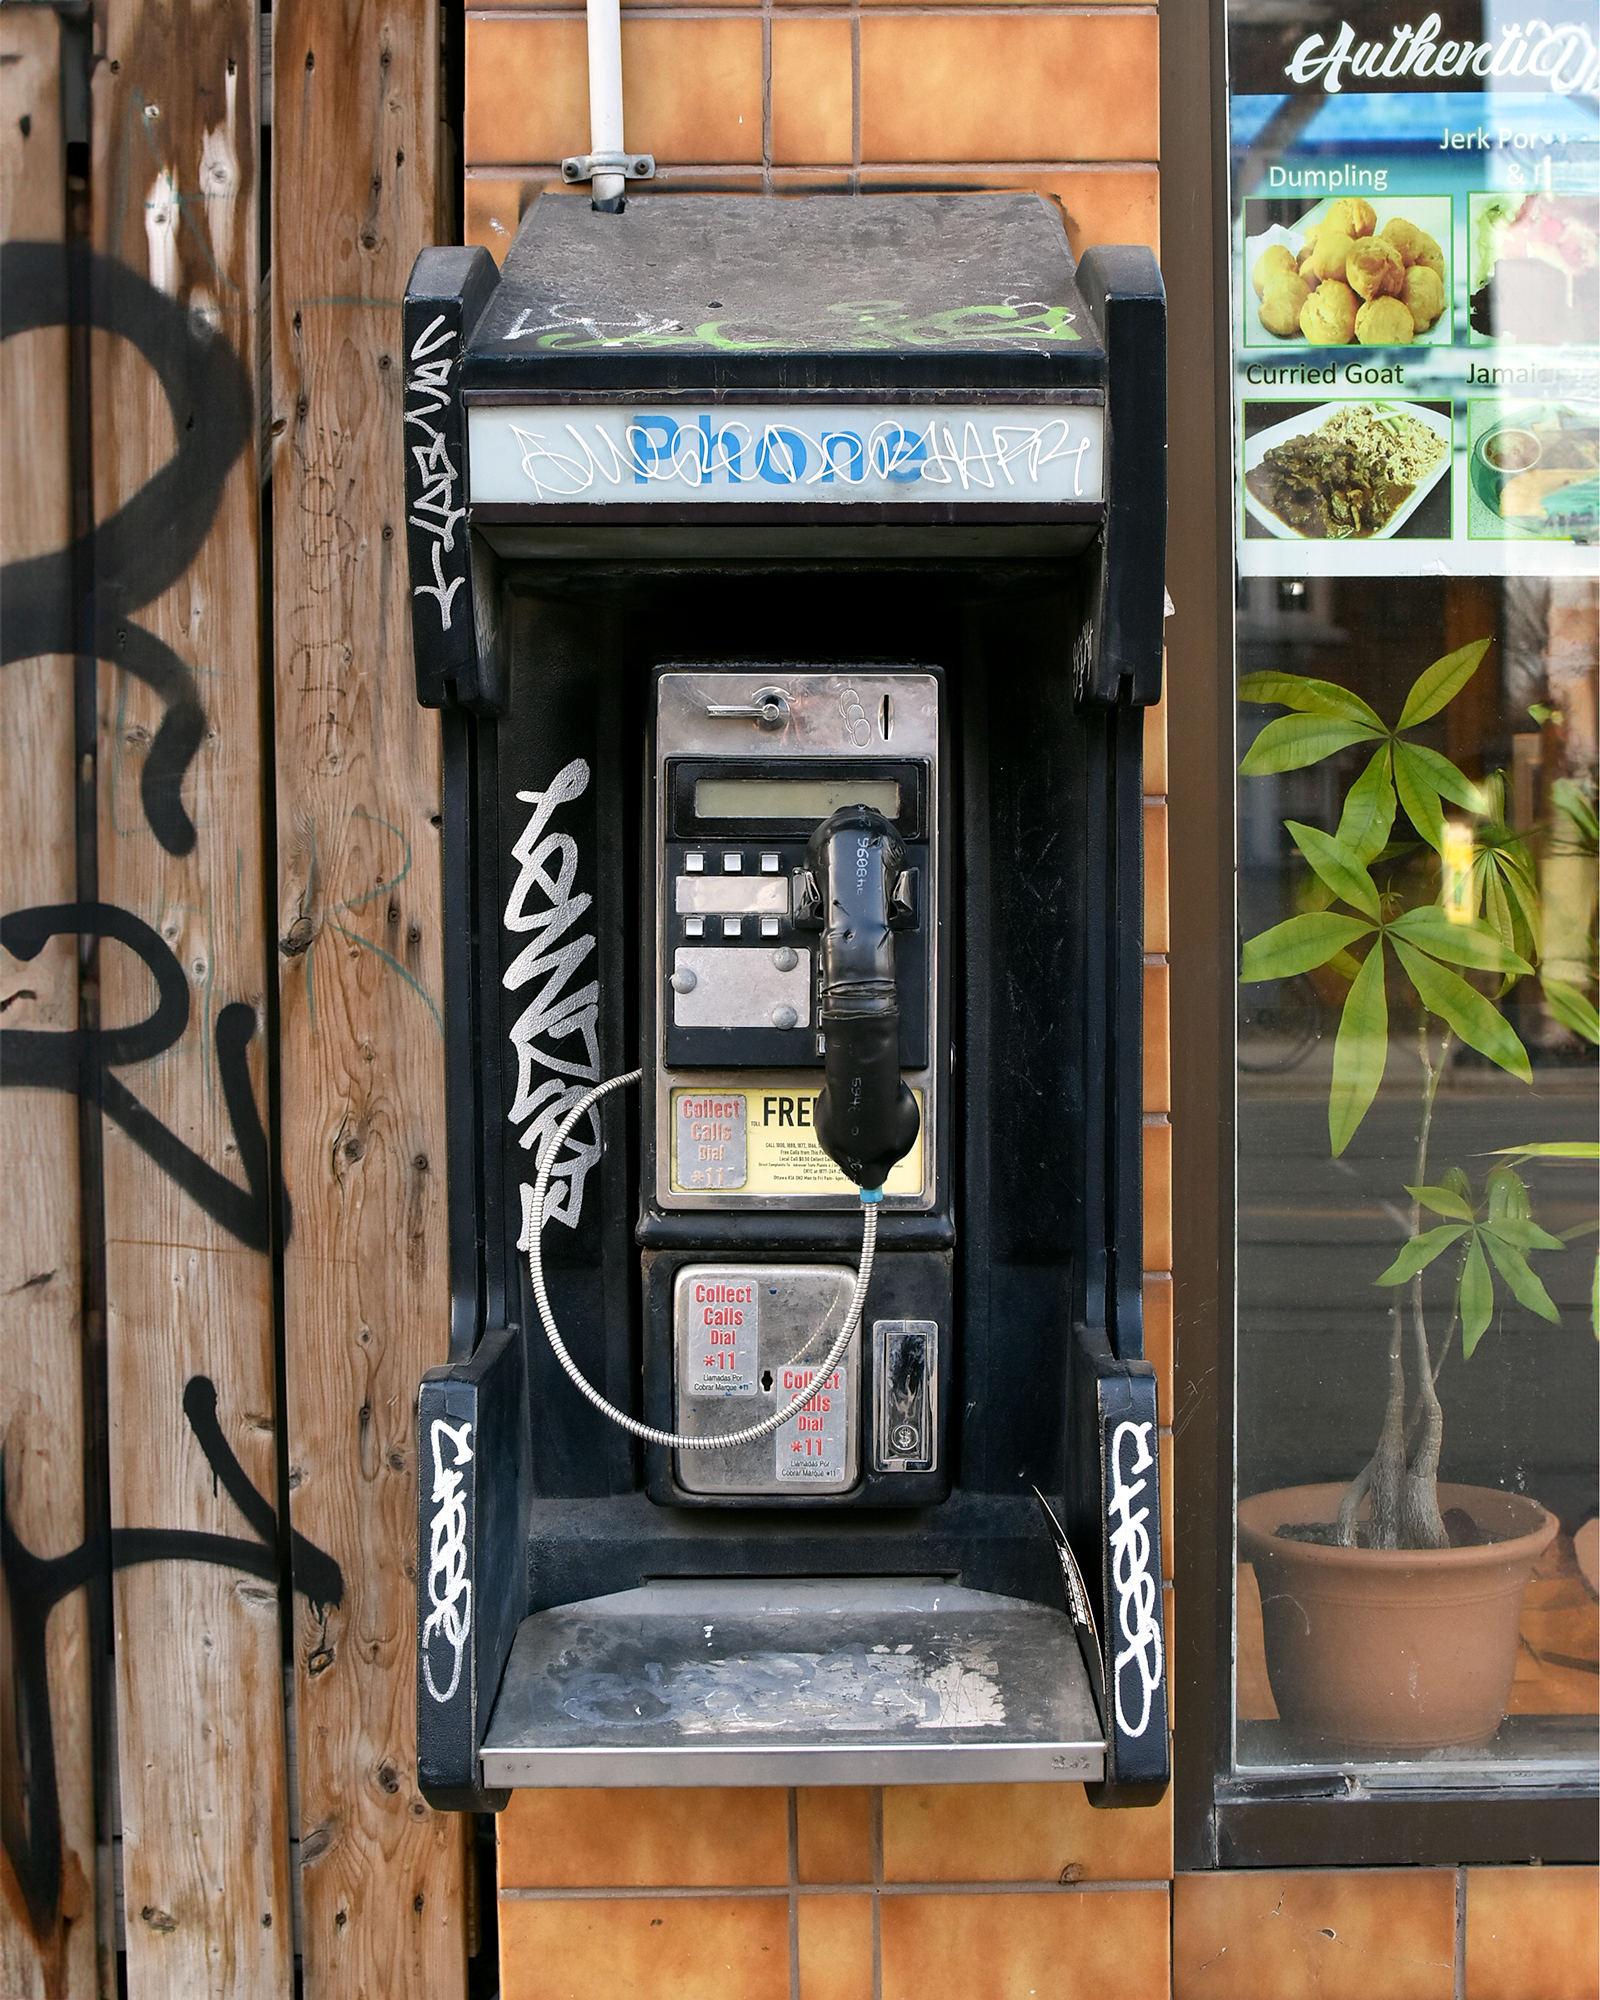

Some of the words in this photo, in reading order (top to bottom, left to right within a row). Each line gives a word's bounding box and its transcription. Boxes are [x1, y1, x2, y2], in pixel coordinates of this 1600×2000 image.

[1439, 126, 1491, 150] Jerk
[1269, 165, 1389, 191] Dumpling
[1246, 362, 1337, 385] Curried
[1344, 363, 1405, 385] Goat
[633, 414, 928, 485] Phone
[683, 1099, 740, 1118] Collect
[691, 1121, 732, 1141] Calls
[698, 1144, 725, 1161] Dial
[695, 1283, 753, 1303] Collect
[703, 1306, 744, 1326] Calls
[710, 1329, 736, 1345] Dial
[694, 1383, 714, 1391] Cobrar
[715, 1383, 738, 1392] Marque
[703, 1374, 731, 1382] Llamadas
[732, 1374, 743, 1382] Por
[783, 1370, 840, 1389] Collct
[798, 1415, 824, 1431] Dial
[781, 1469, 801, 1477] Cobrar
[802, 1469, 824, 1478] Marque
[790, 1460, 818, 1468] Llamadas
[819, 1460, 830, 1468] Por
